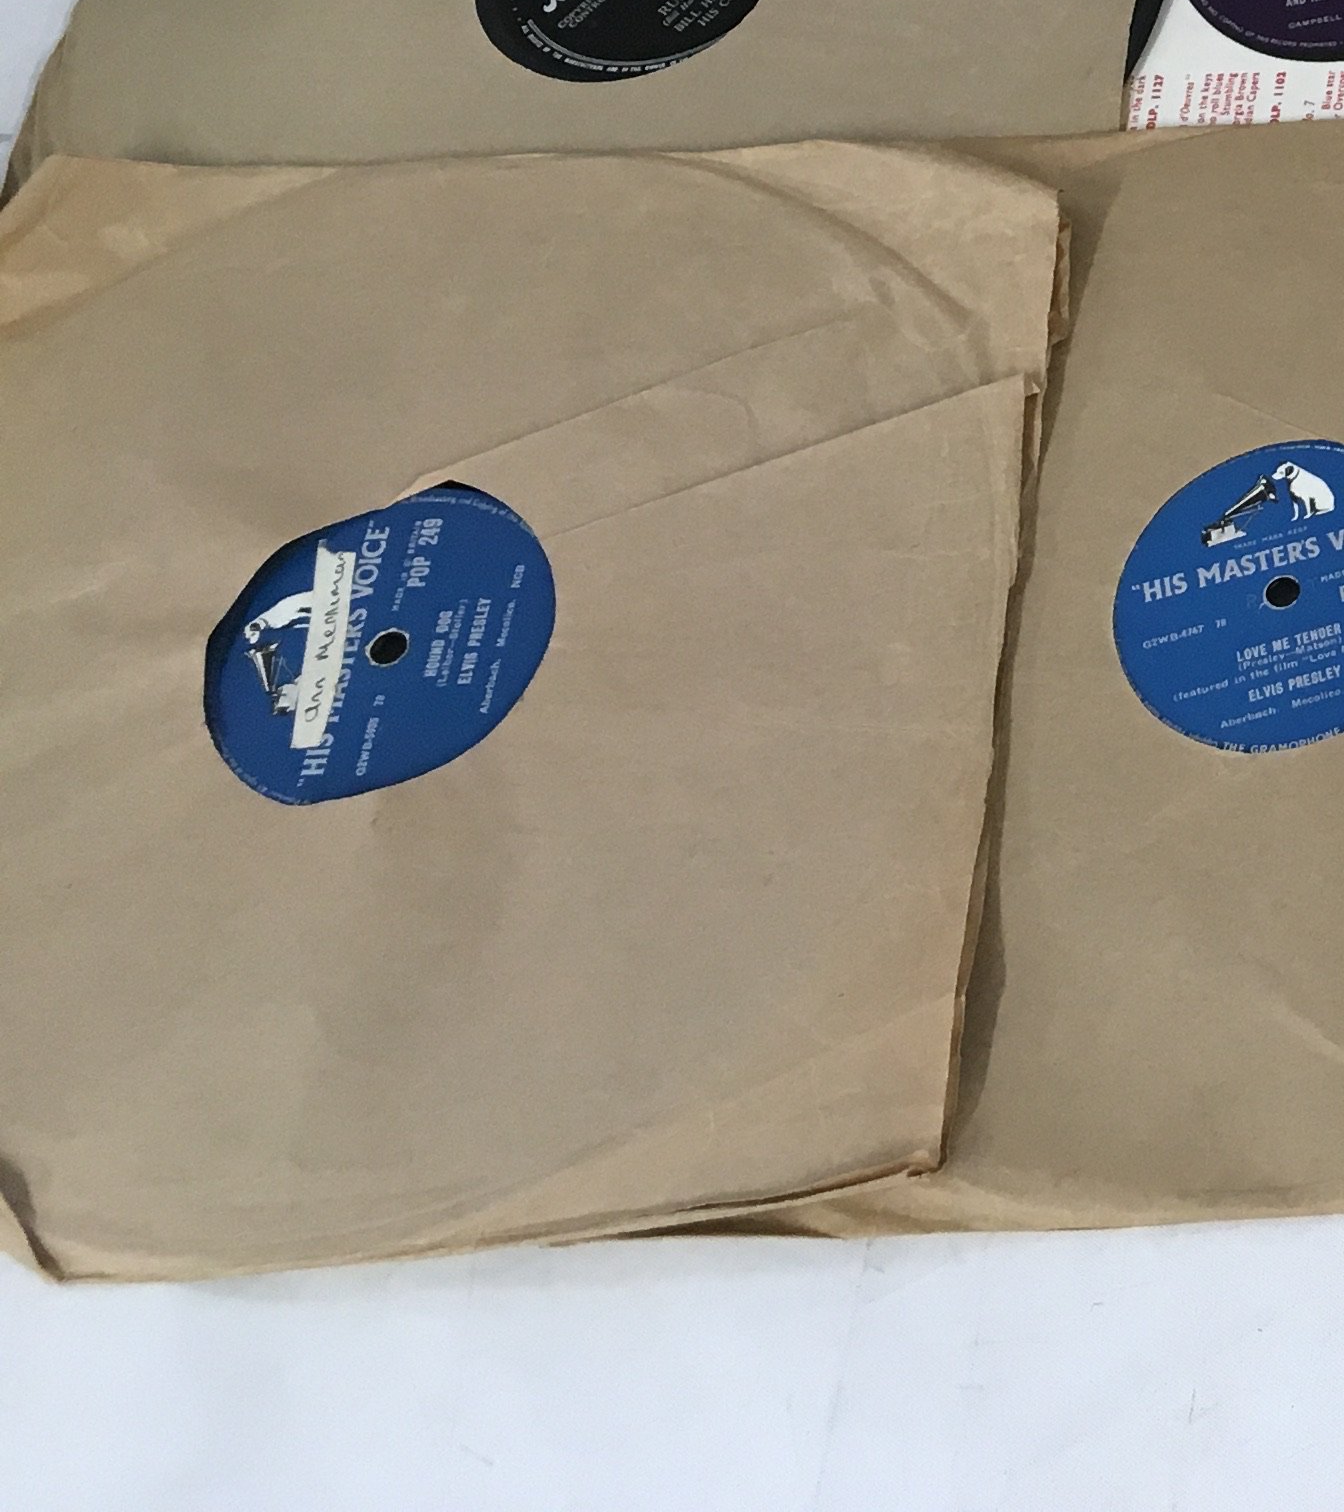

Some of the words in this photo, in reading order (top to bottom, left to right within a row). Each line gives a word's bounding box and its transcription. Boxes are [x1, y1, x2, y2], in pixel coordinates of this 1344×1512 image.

[674, 6, 702, 32] BILL
[698, 2, 719, 28] HIS
[418, 517, 444, 546] 249
[407, 556, 431, 588] POP
[1197, 536, 1321, 588] MASTER'S
[424, 638, 446, 679] HOUND
[435, 610, 453, 633] DOG
[457, 653, 477, 685] ELVIS
[467, 598, 492, 649] PRESLEY
[1236, 645, 1268, 663] LOVE
[1272, 638, 1291, 653] ME
[1295, 623, 1342, 647] TENDER
[1248, 682, 1285, 703] ELVIS
[1288, 665, 1342, 691] PRESLEY
